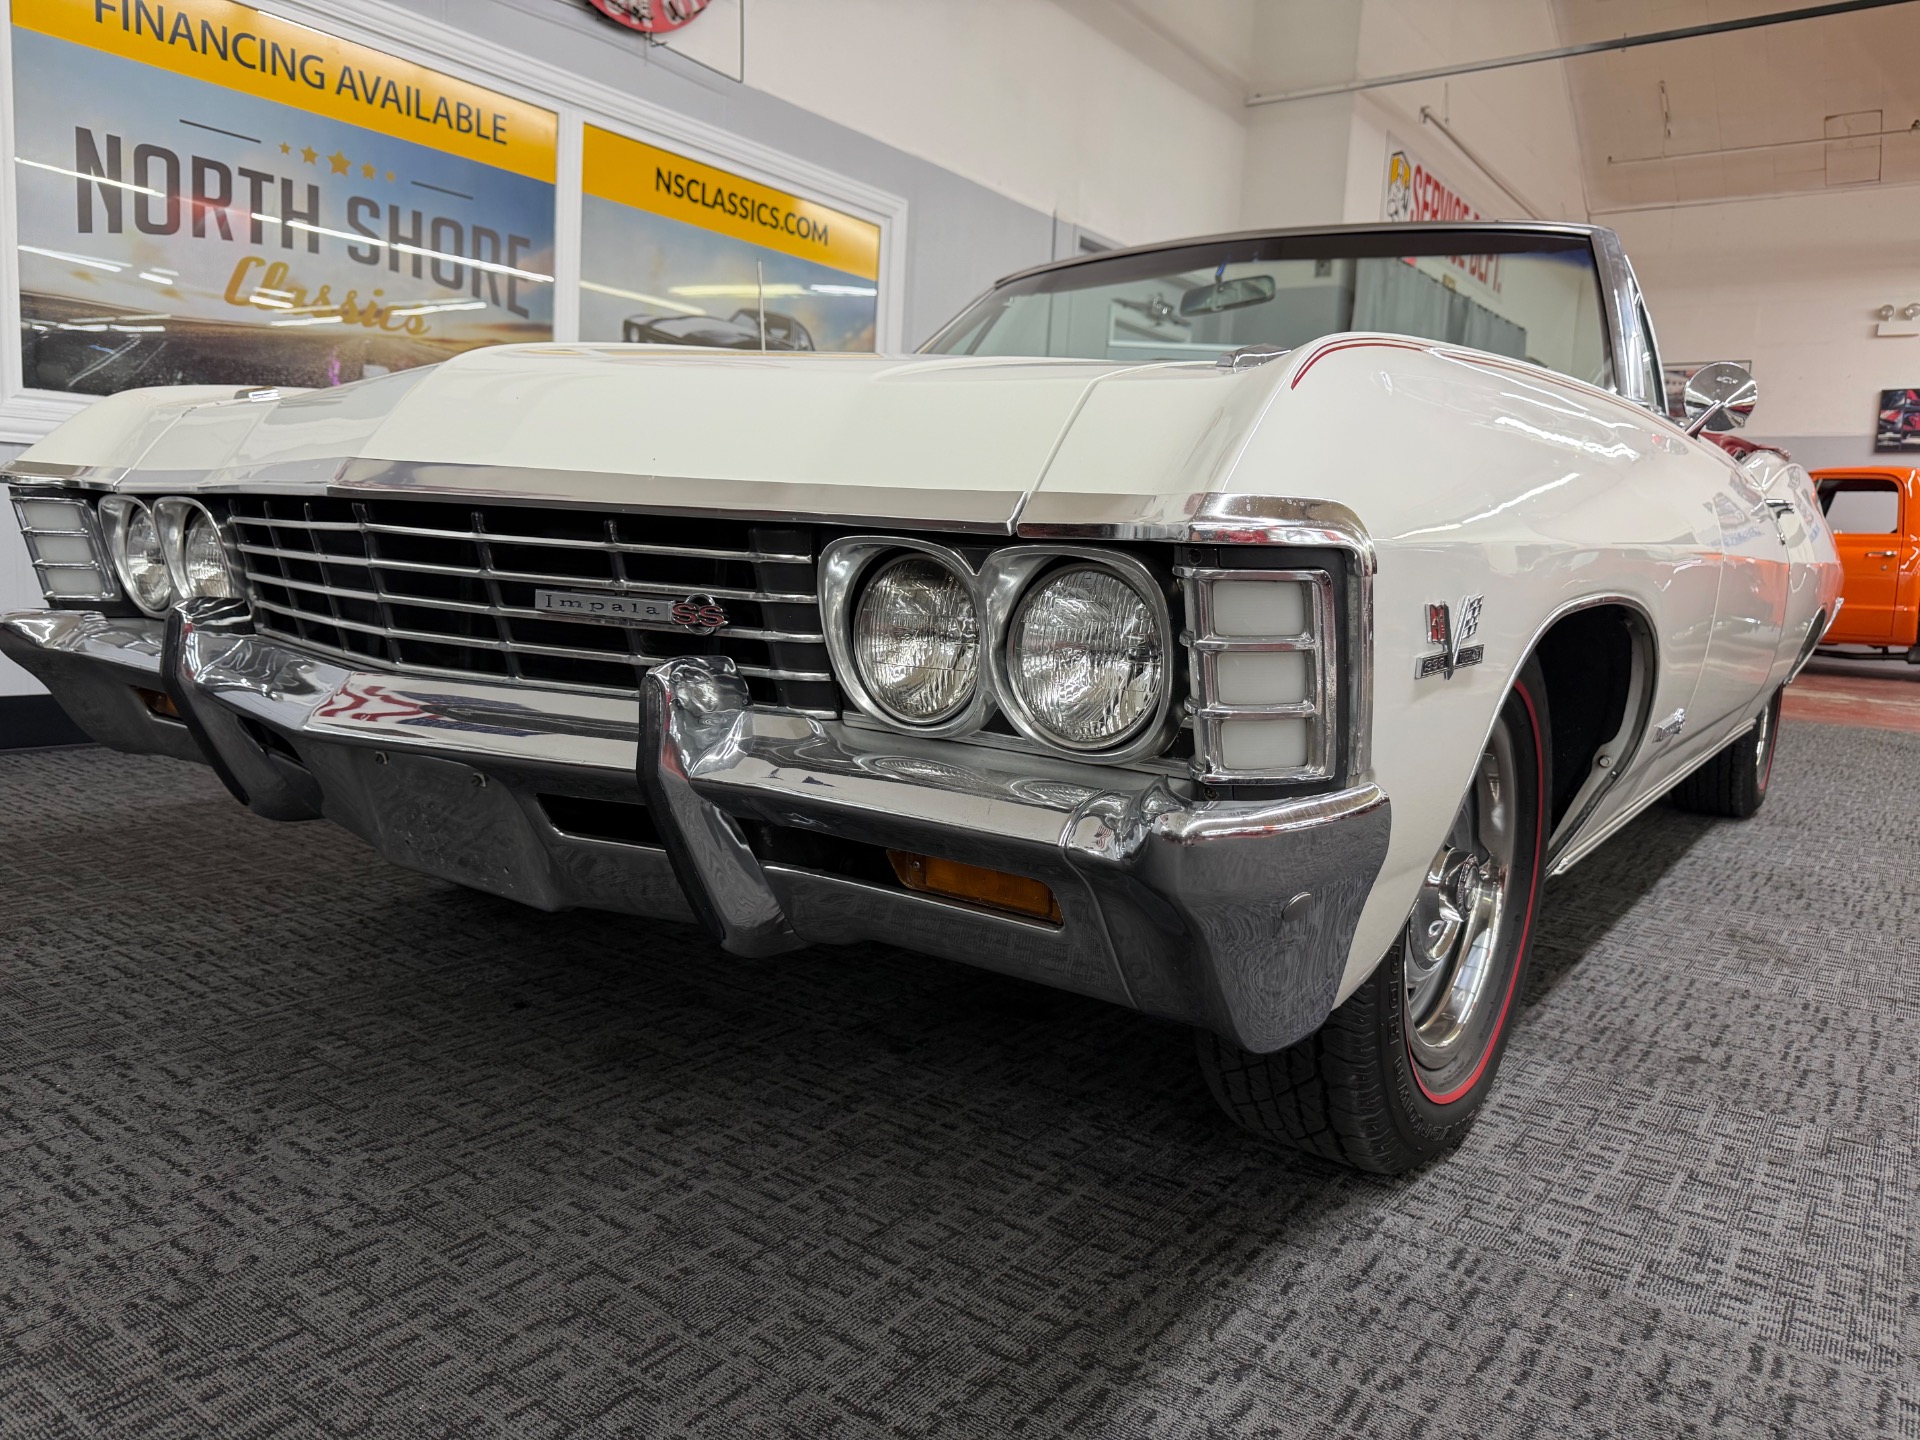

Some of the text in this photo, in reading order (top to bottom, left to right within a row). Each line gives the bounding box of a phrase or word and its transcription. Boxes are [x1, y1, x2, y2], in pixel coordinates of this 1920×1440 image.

[95, 0, 508, 146] FINANCING AVAILABLE
[75, 126, 531, 320] NORTH SHORE
[655, 166, 829, 246] NSCLASSICS.COM
[223, 255, 432, 336] Classics
[545, 594, 726, 628] Impala SS
